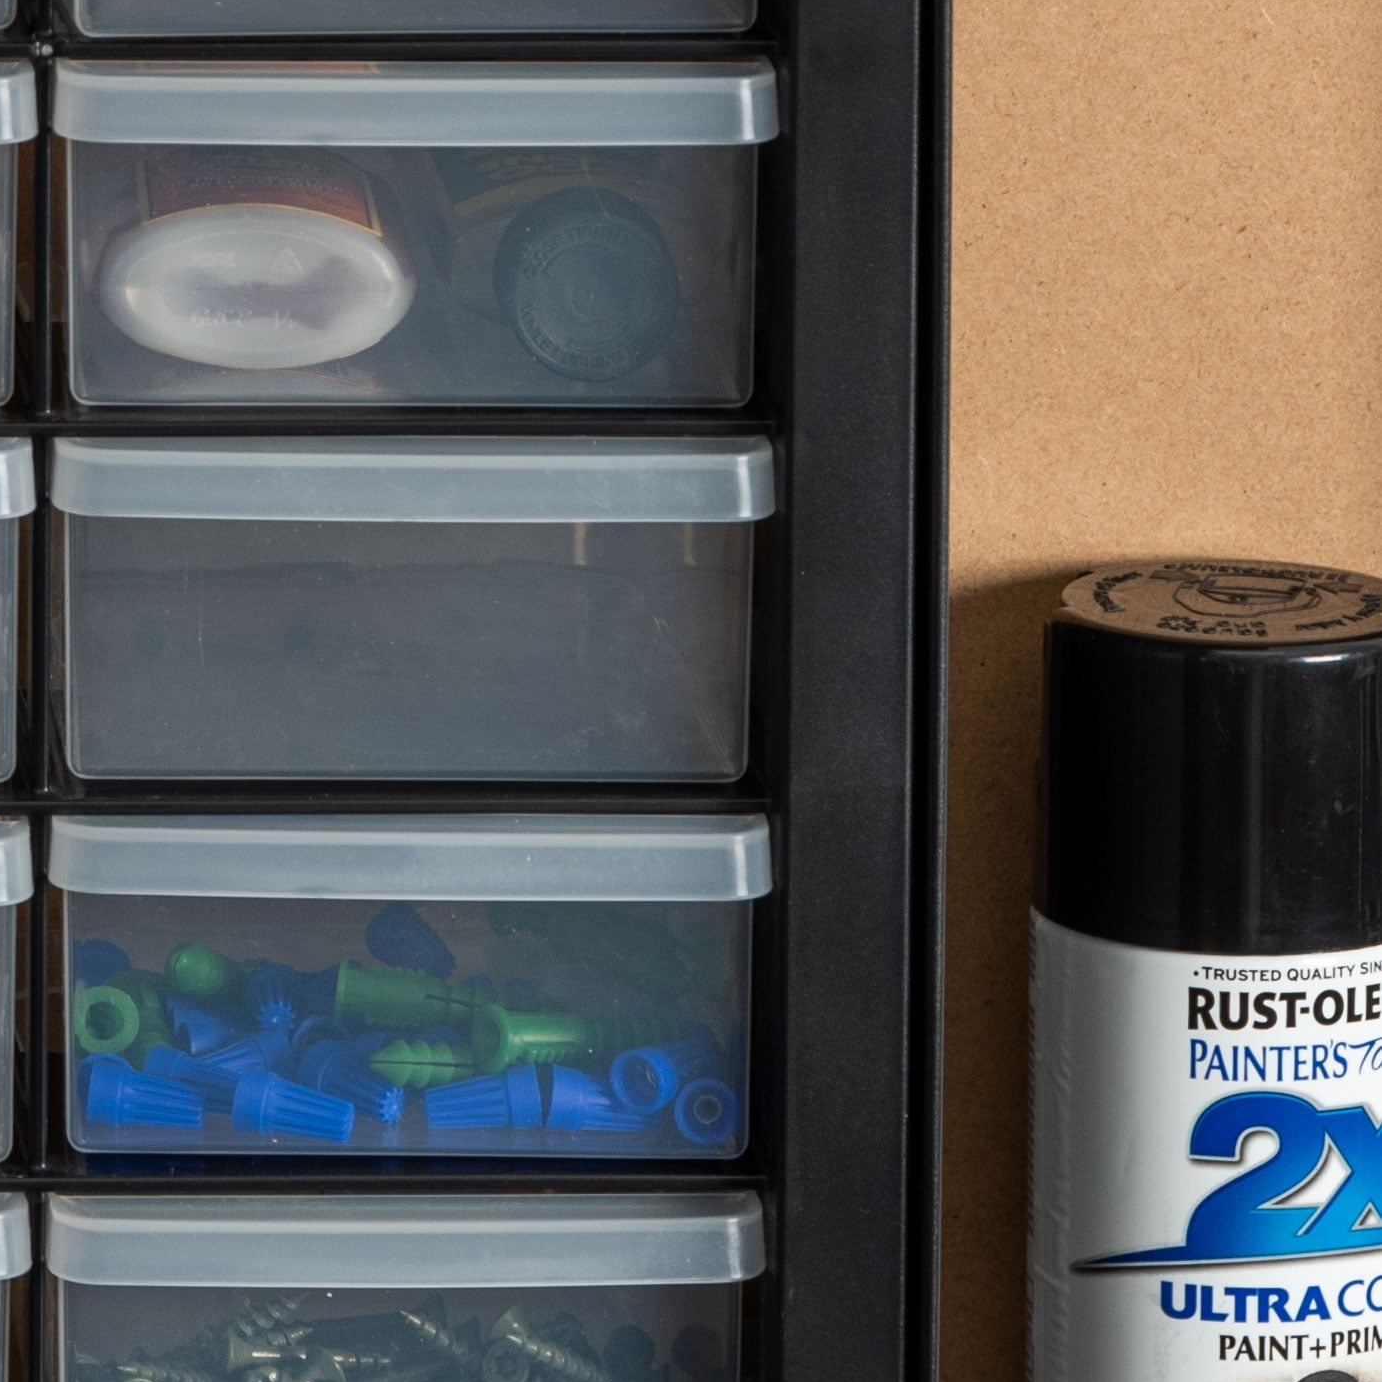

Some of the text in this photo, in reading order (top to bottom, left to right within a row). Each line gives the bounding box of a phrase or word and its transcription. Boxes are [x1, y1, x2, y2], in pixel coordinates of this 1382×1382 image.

[1201, 965, 1282, 982] TRUSTED
[1286, 963, 1356, 982] QUALITY
[1187, 983, 1382, 1031] RUST-OLE
[1189, 1037, 1348, 1083] PAINTER'S
[1160, 1279, 1333, 1324] ULTRA
